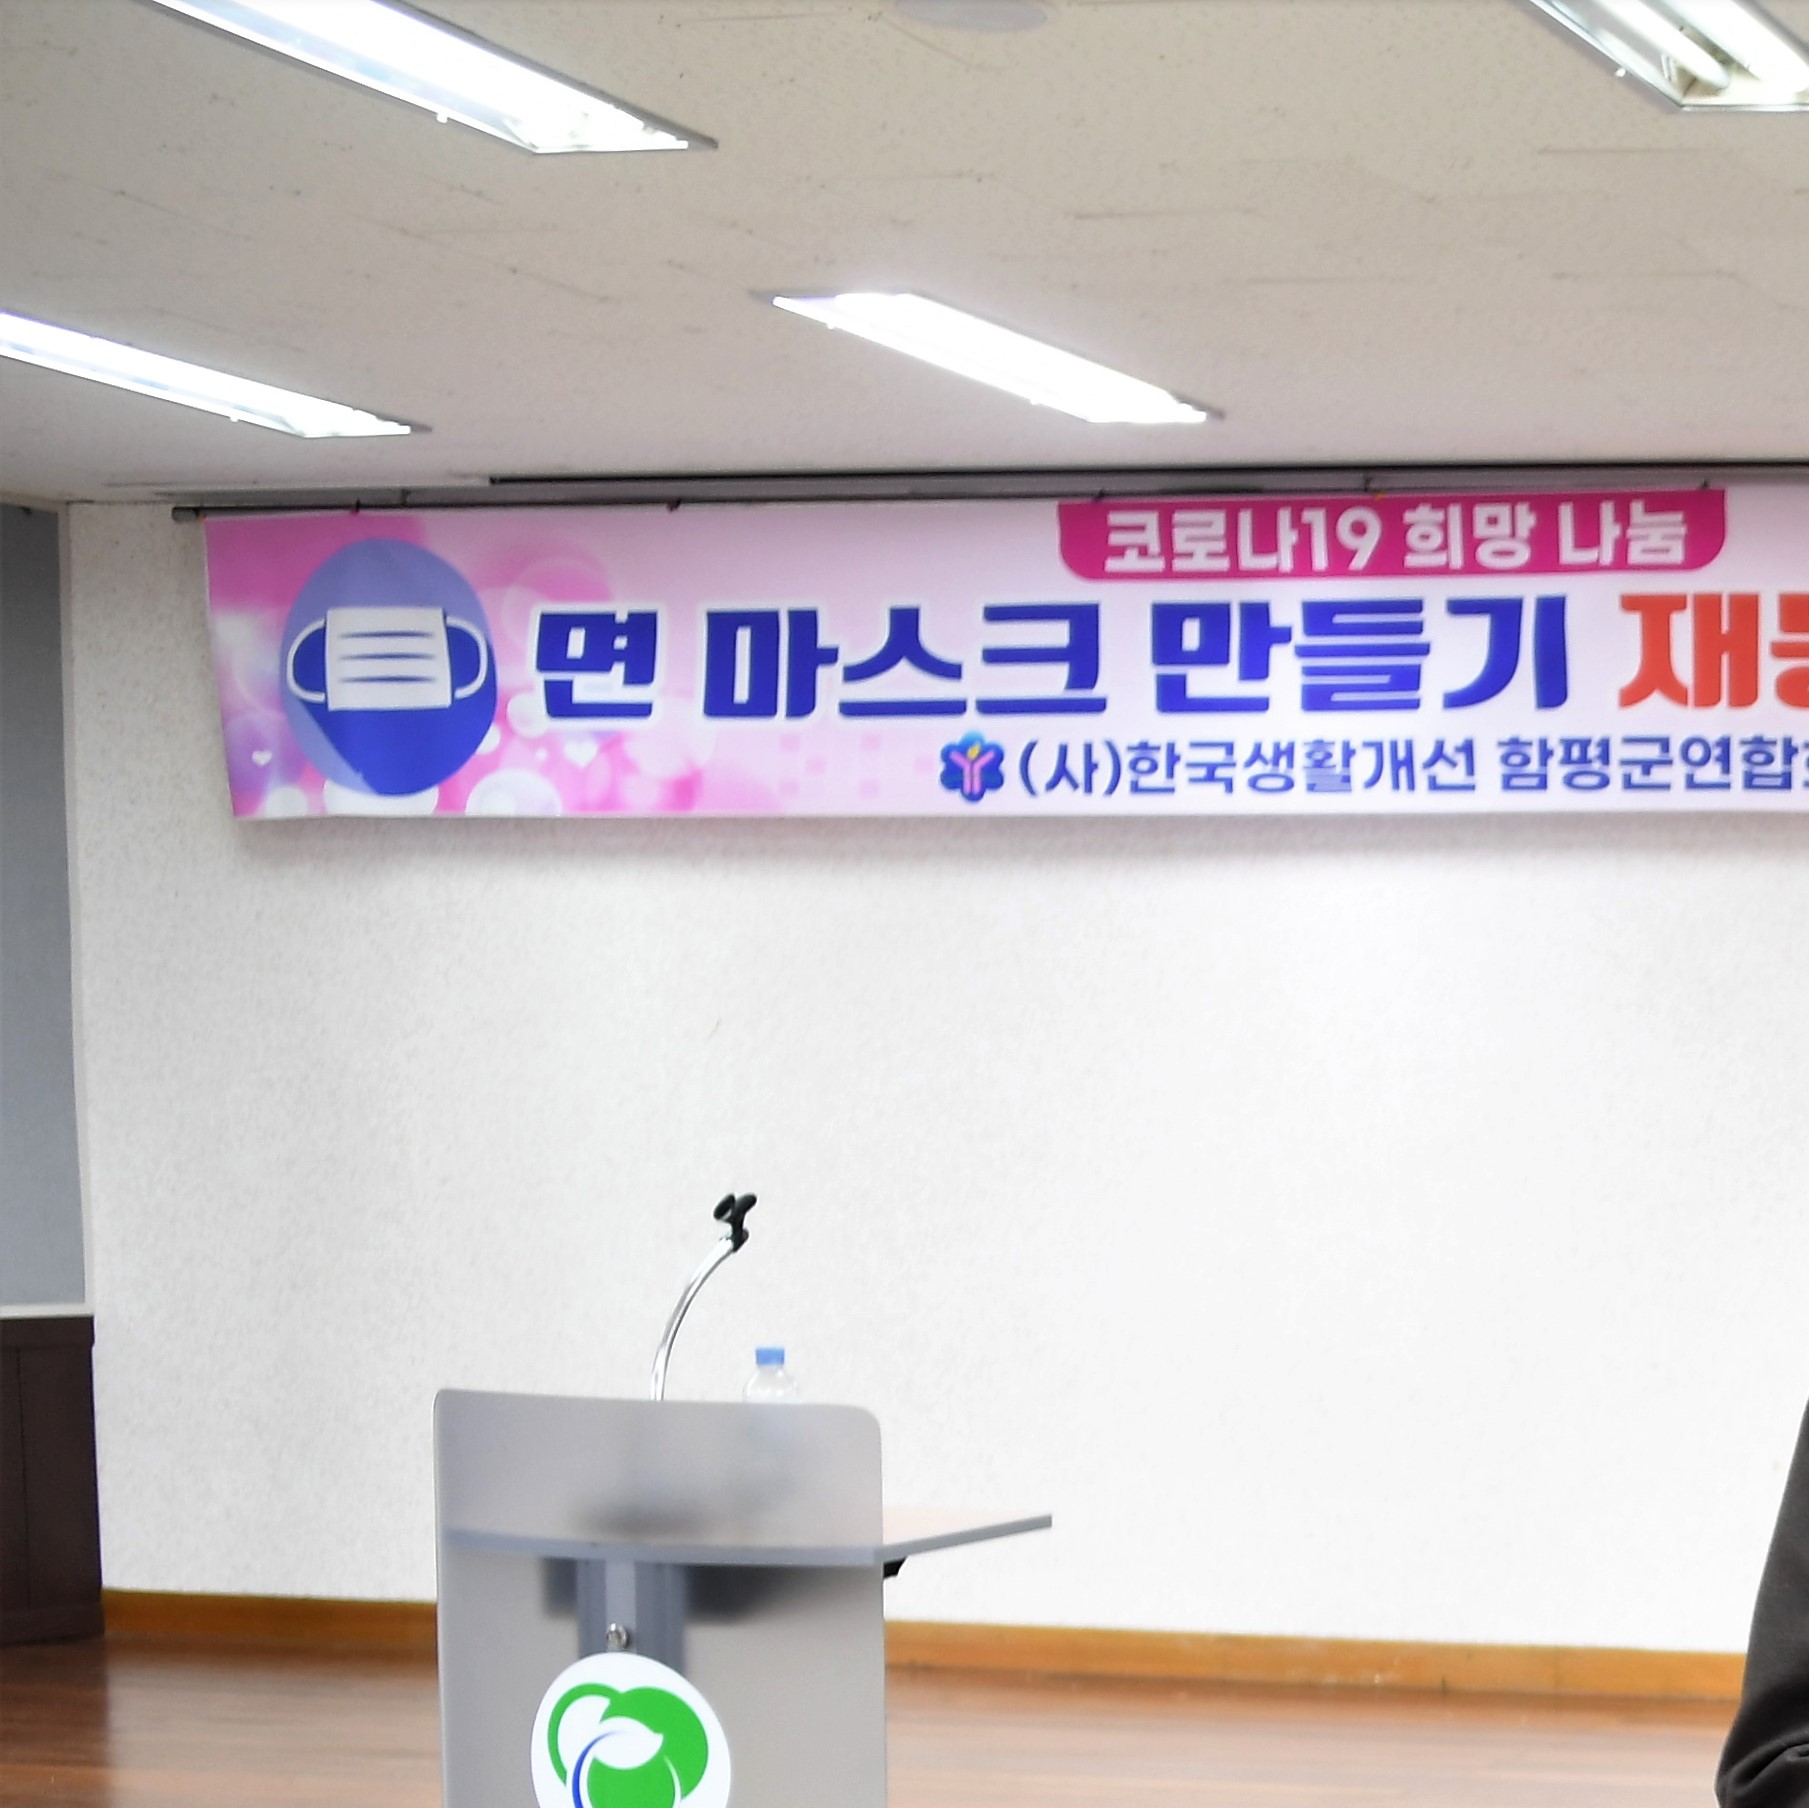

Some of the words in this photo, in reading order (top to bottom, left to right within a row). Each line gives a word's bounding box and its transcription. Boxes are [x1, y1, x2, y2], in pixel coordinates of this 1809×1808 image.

[1104, 507, 1381, 574] 코로나19
[1402, 501, 1536, 570] 희망
[1557, 499, 1688, 566] 나눔
[536, 608, 659, 720] 면
[702, 602, 1108, 720] 마스크
[1150, 595, 1570, 714] 만들기
[1019, 738, 1477, 798] (사)한국생활개선
